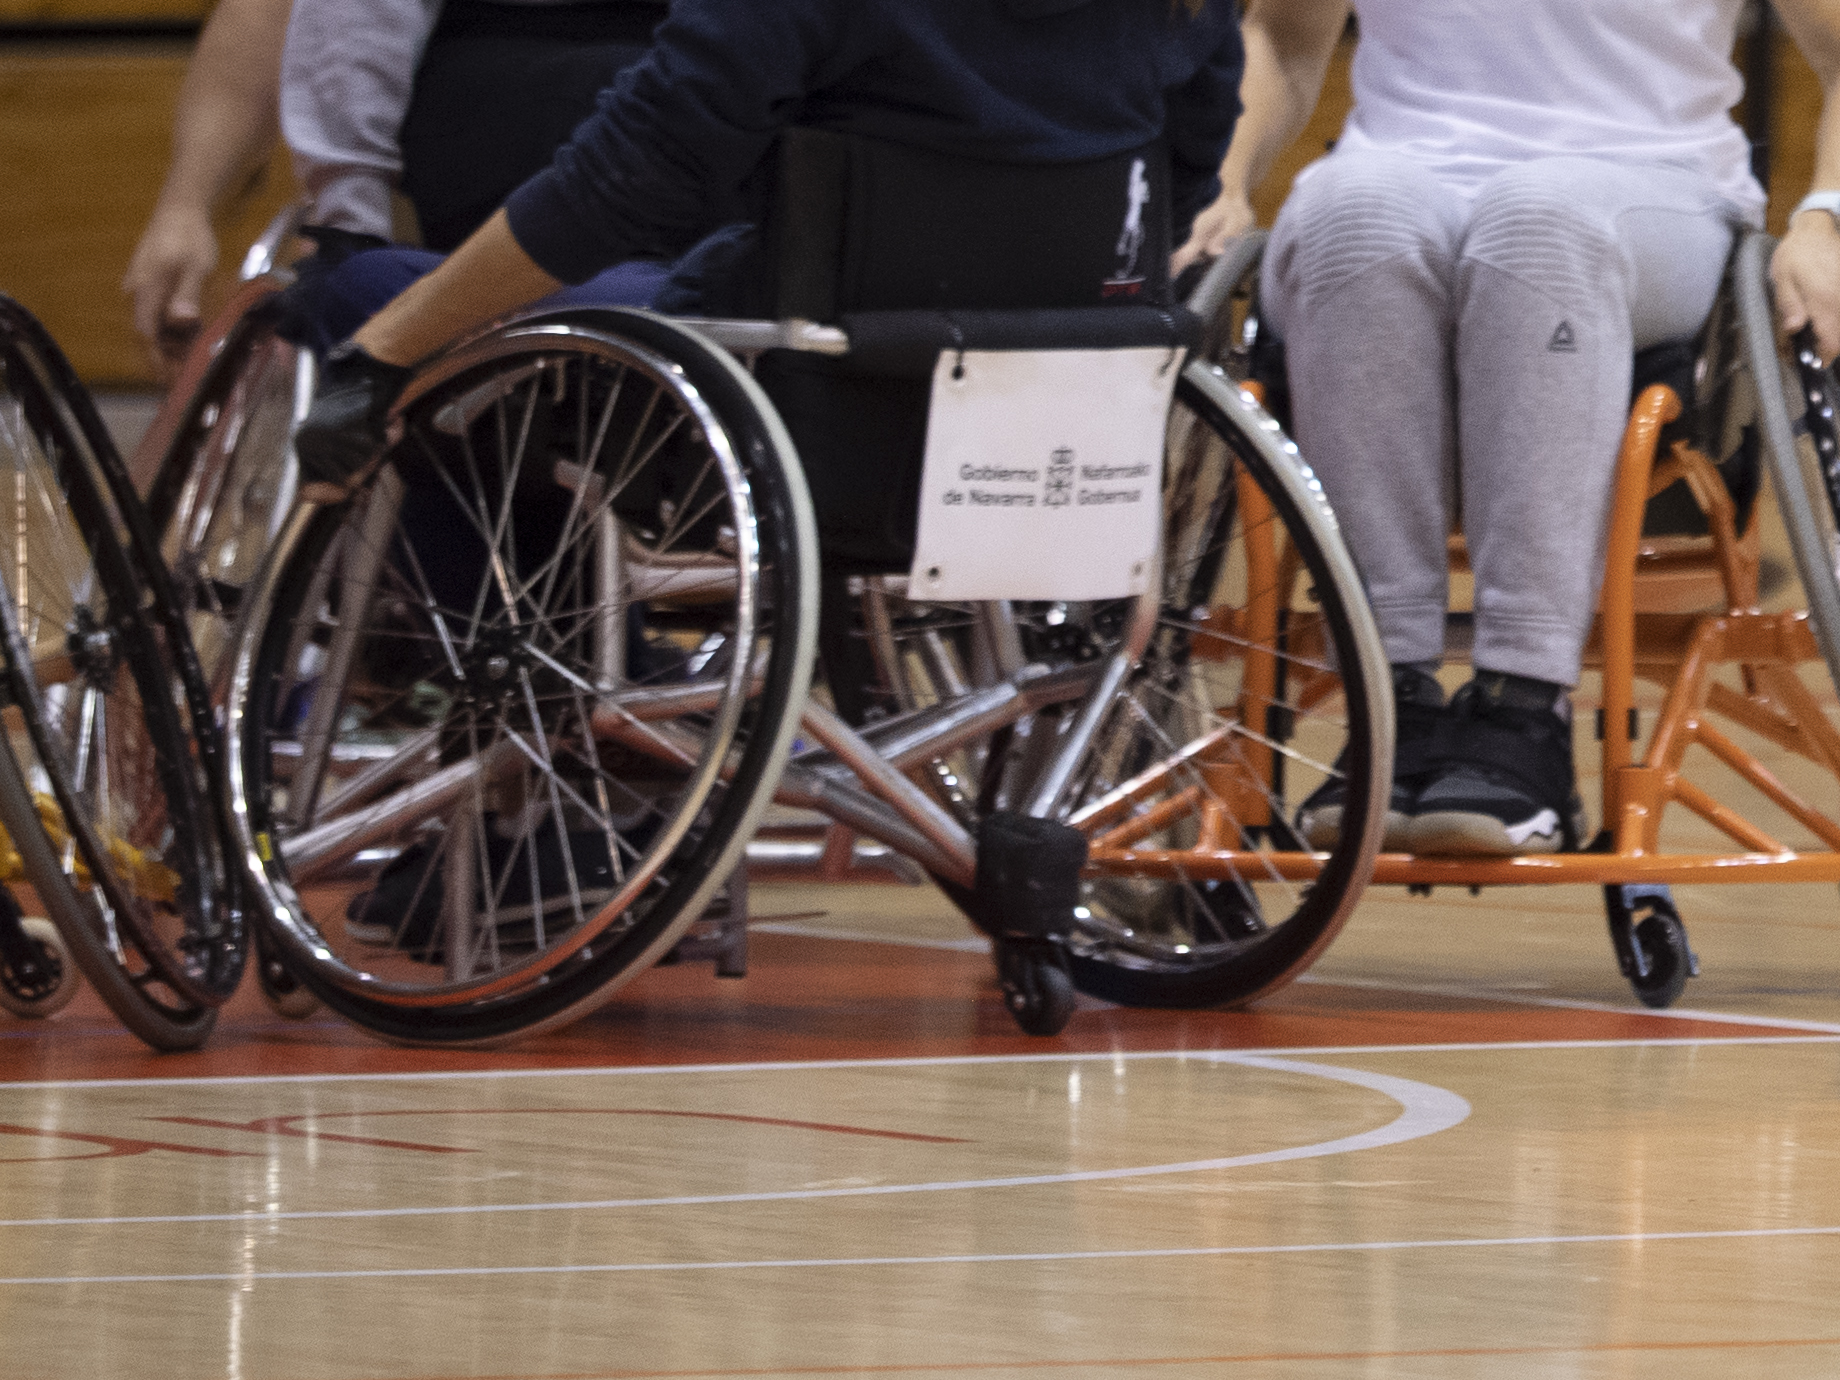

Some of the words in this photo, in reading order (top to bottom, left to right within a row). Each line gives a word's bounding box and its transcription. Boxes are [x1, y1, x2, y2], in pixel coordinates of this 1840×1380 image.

[958, 463, 1038, 482] Gobierno
[941, 489, 964, 506] de
[968, 489, 1036, 507] Navarra
